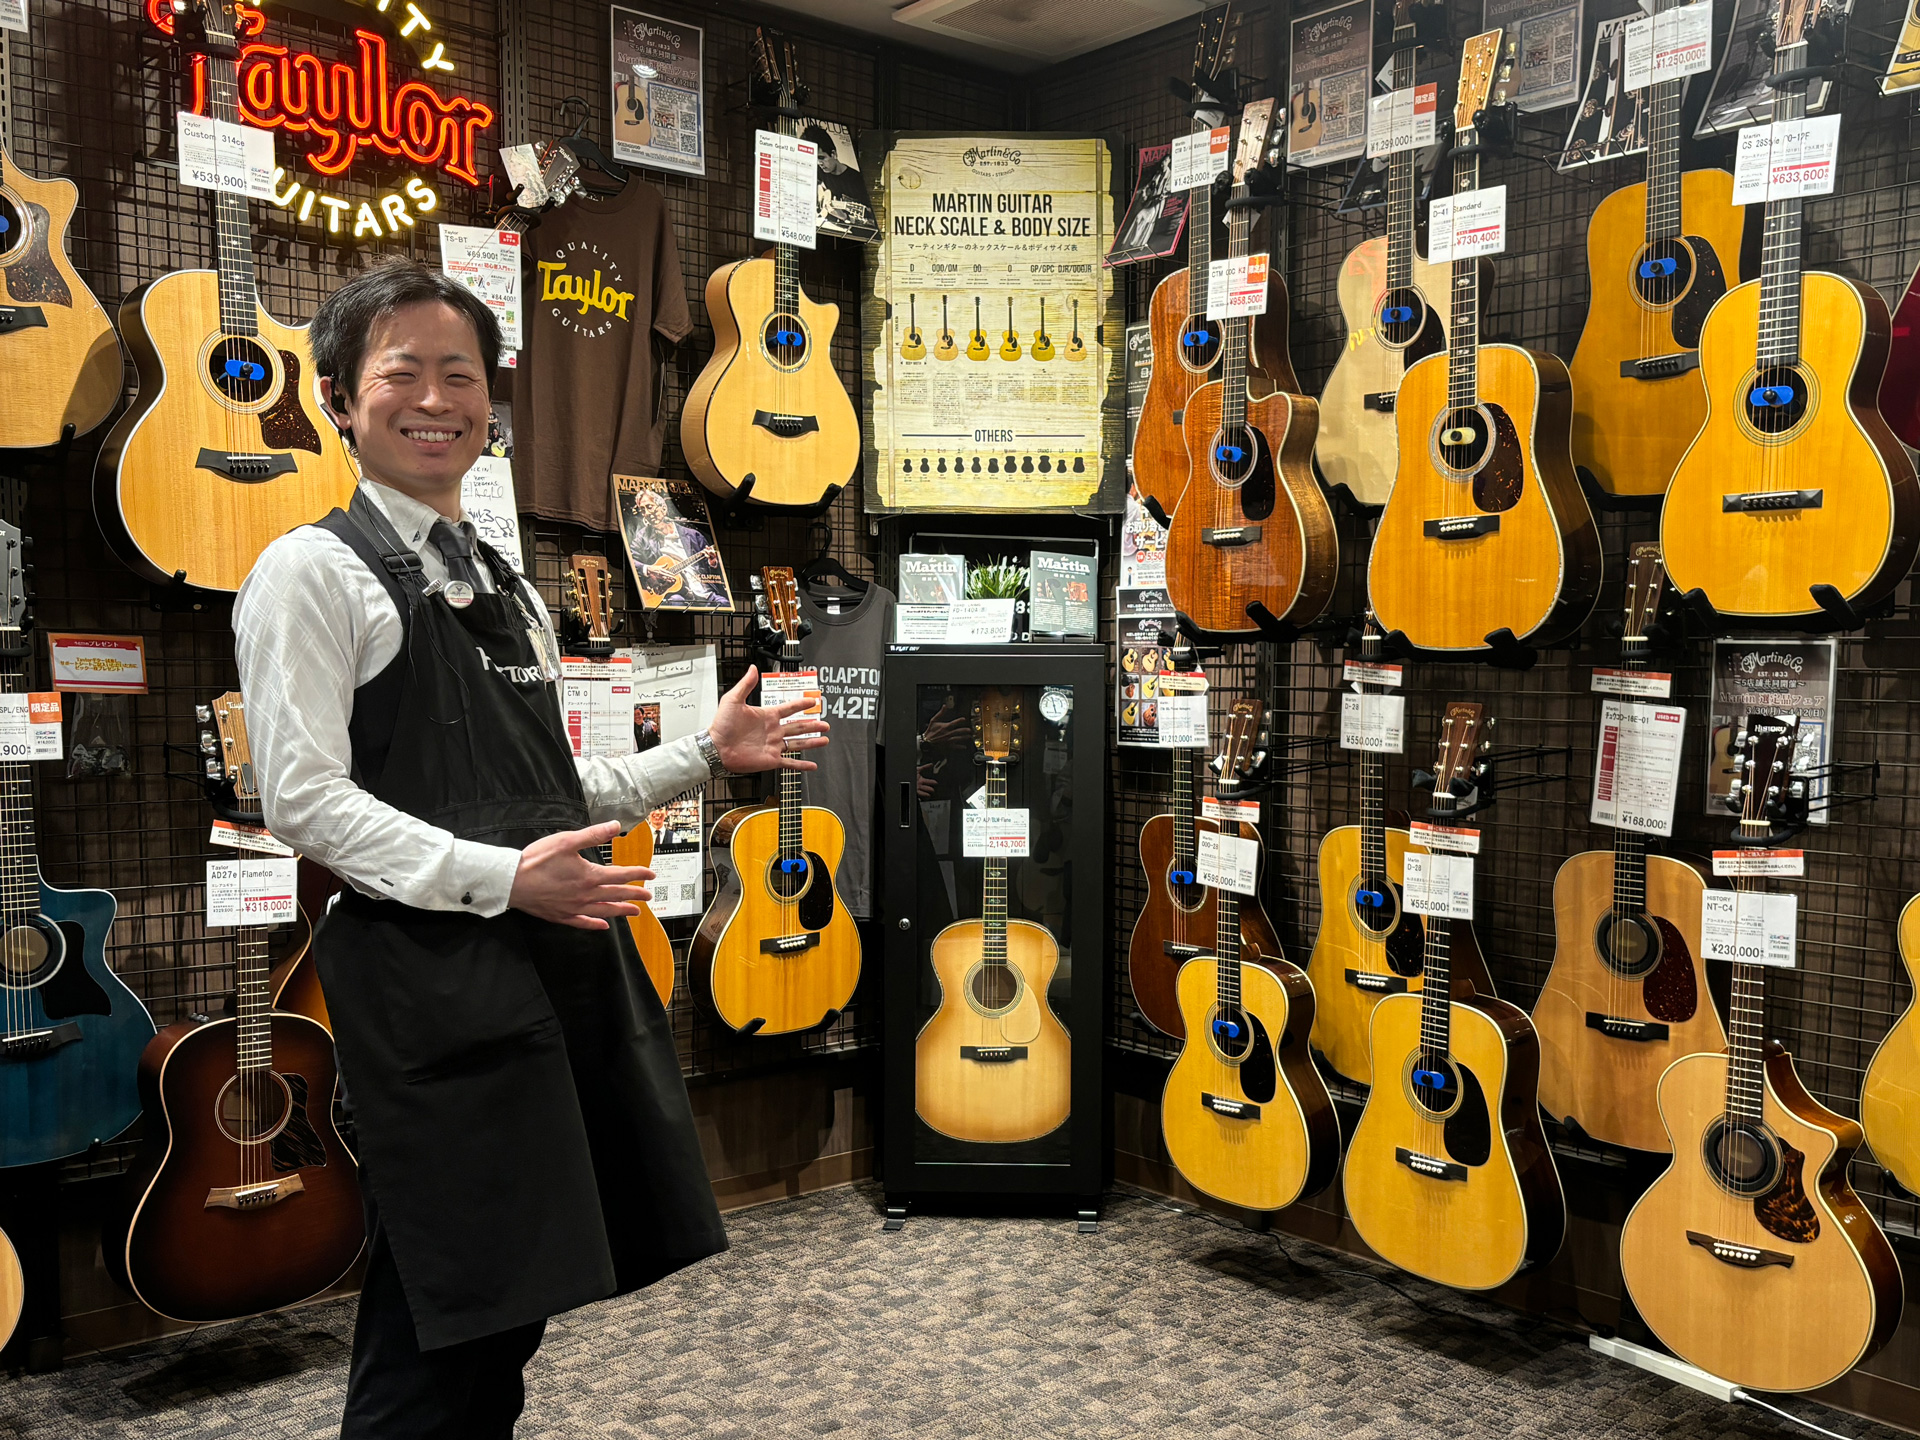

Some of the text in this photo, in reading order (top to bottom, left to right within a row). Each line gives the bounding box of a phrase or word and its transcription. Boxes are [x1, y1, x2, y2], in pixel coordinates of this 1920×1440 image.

[184, 120, 201, 128] Taylor
[184, 128, 245, 146] Custom 314ce
[192, 170, 244, 188] ¥539,900
[1772, 168, 1824, 184] ¥633,600
[272, 167, 438, 238] UITARS
[932, 193, 1052, 214] MARTIN GUITAR
[1433, 201, 1482, 218] D-41 Standard
[894, 216, 1090, 238] NECK SCALE & BODY SIZE
[445, 234, 468, 244] TS-BT
[782, 229, 810, 242] ¥548,000
[1456, 230, 1496, 246] ¥730,400
[556, 242, 622, 282] QUALITY
[537, 260, 635, 323] Taylor
[1230, 294, 1262, 306] ¥958,500
[552, 308, 612, 338] GUITARS
[974, 430, 1013, 442] OTHERS
[1135, 533, 1166, 550] サービ
[906, 560, 958, 573] Martin
[1038, 557, 1090, 572] Martin
[820, 666, 880, 686] CLAPTO
[31, 702, 60, 713] 限定品
[1346, 735, 1380, 747] ¥550,000
[0, 744, 26, 756] ,900
[1622, 814, 1664, 830] ¥168,000
[212, 871, 237, 879] AD27e
[1407, 864, 1422, 872] D-28
[245, 901, 288, 912] ¥318,000
[1410, 898, 1446, 912] ¥555,000
[1706, 903, 1733, 912] NT-C4
[1711, 944, 1760, 958] ¥230,000
